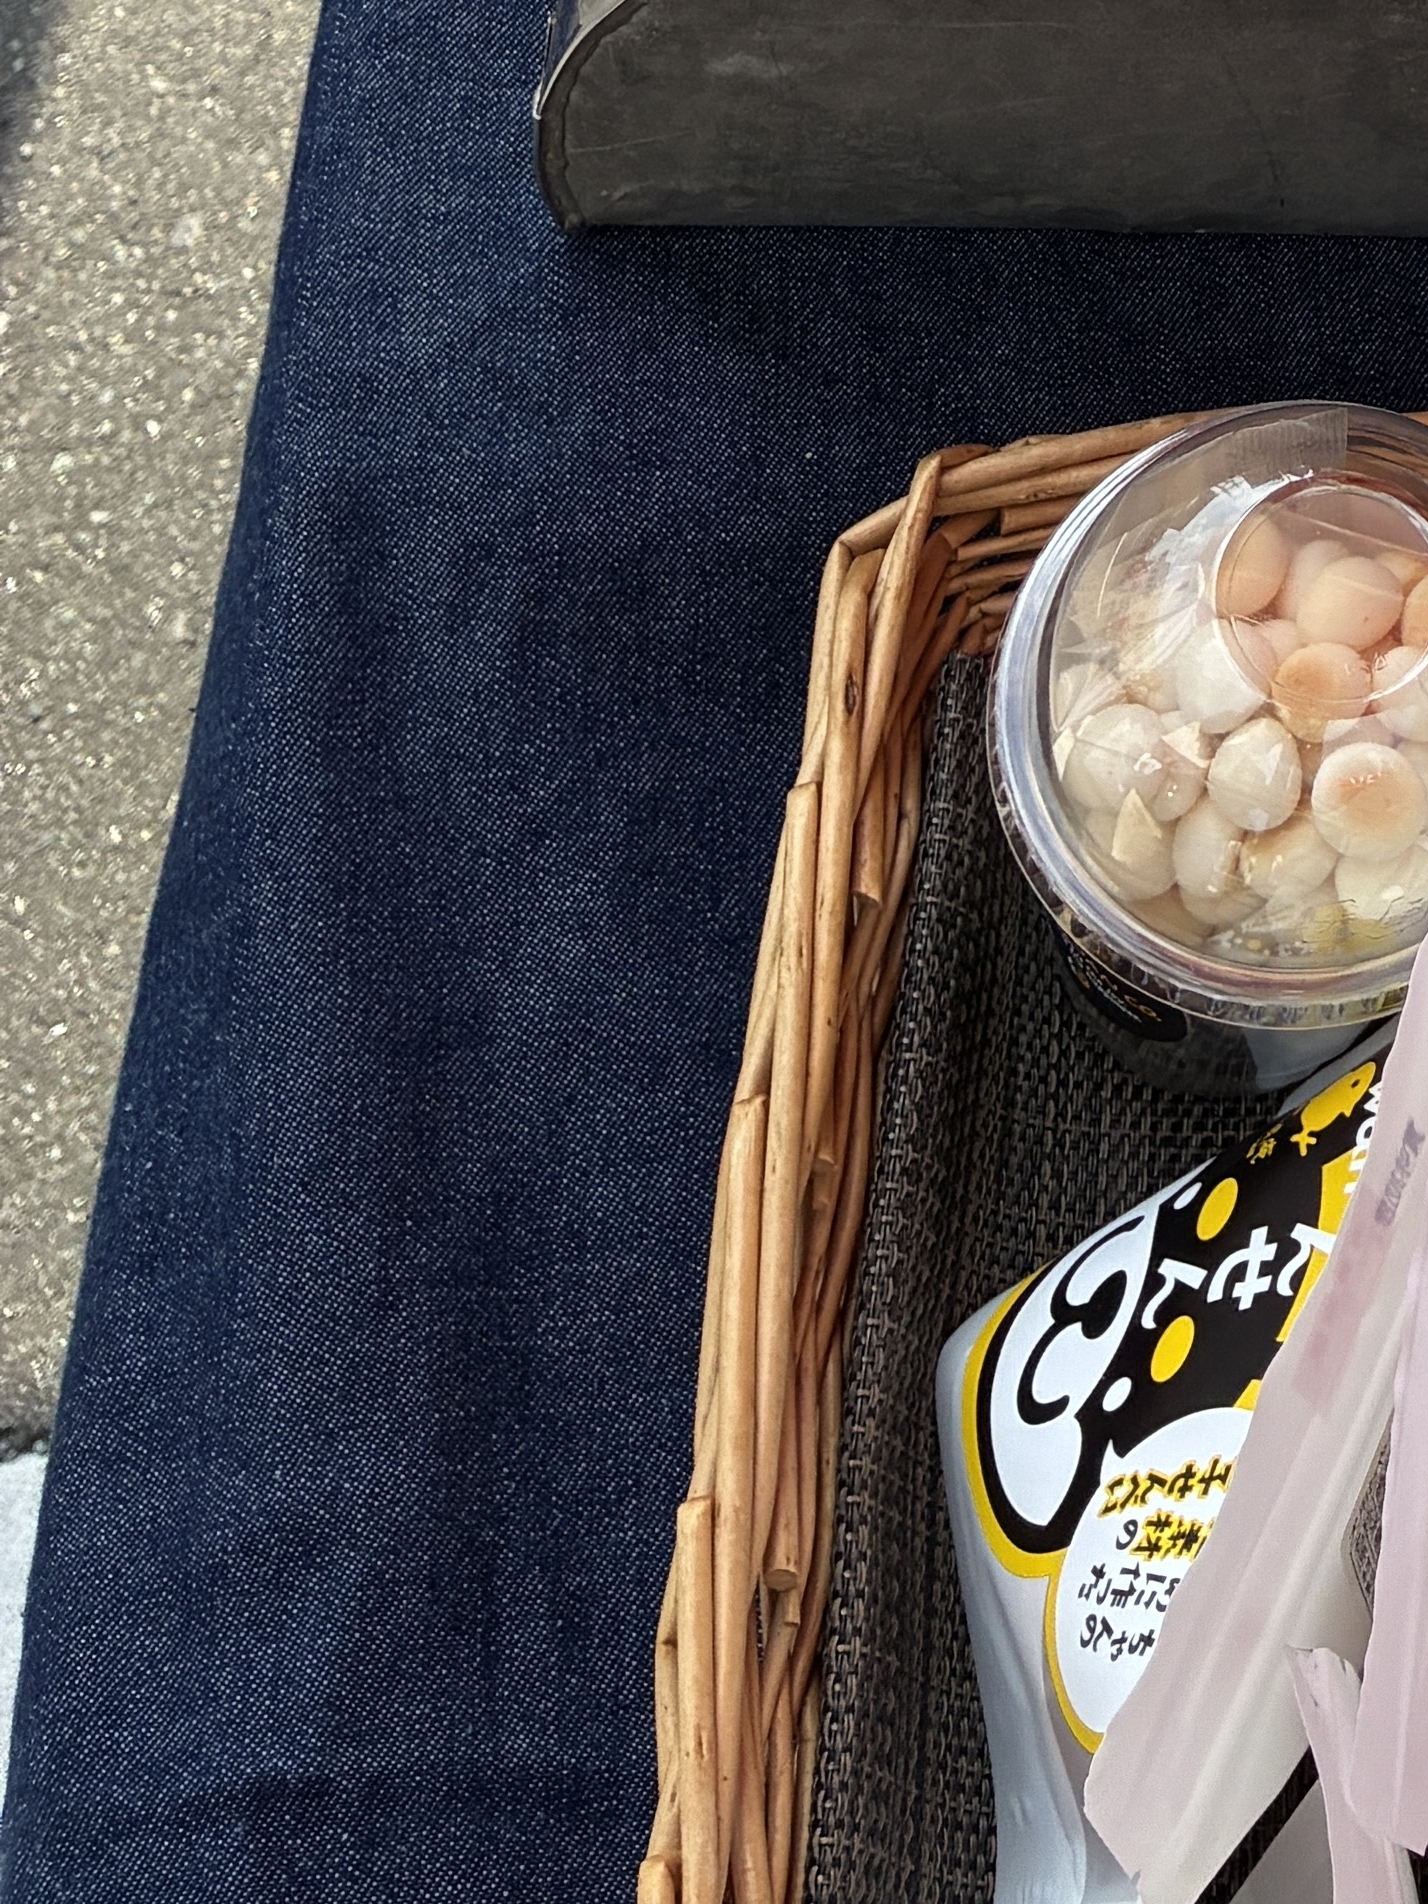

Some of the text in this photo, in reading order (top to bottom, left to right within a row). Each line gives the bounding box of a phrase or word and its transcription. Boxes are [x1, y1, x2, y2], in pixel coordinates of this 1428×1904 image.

[1141, 1223, 1334, 1329] んせん
[1097, 1457, 1231, 1517] 子せんべい
[1112, 1513, 1212, 1562] 素材の
[1077, 1560, 1180, 1614] に作った
[1079, 1611, 1156, 1660] ちゃんの
